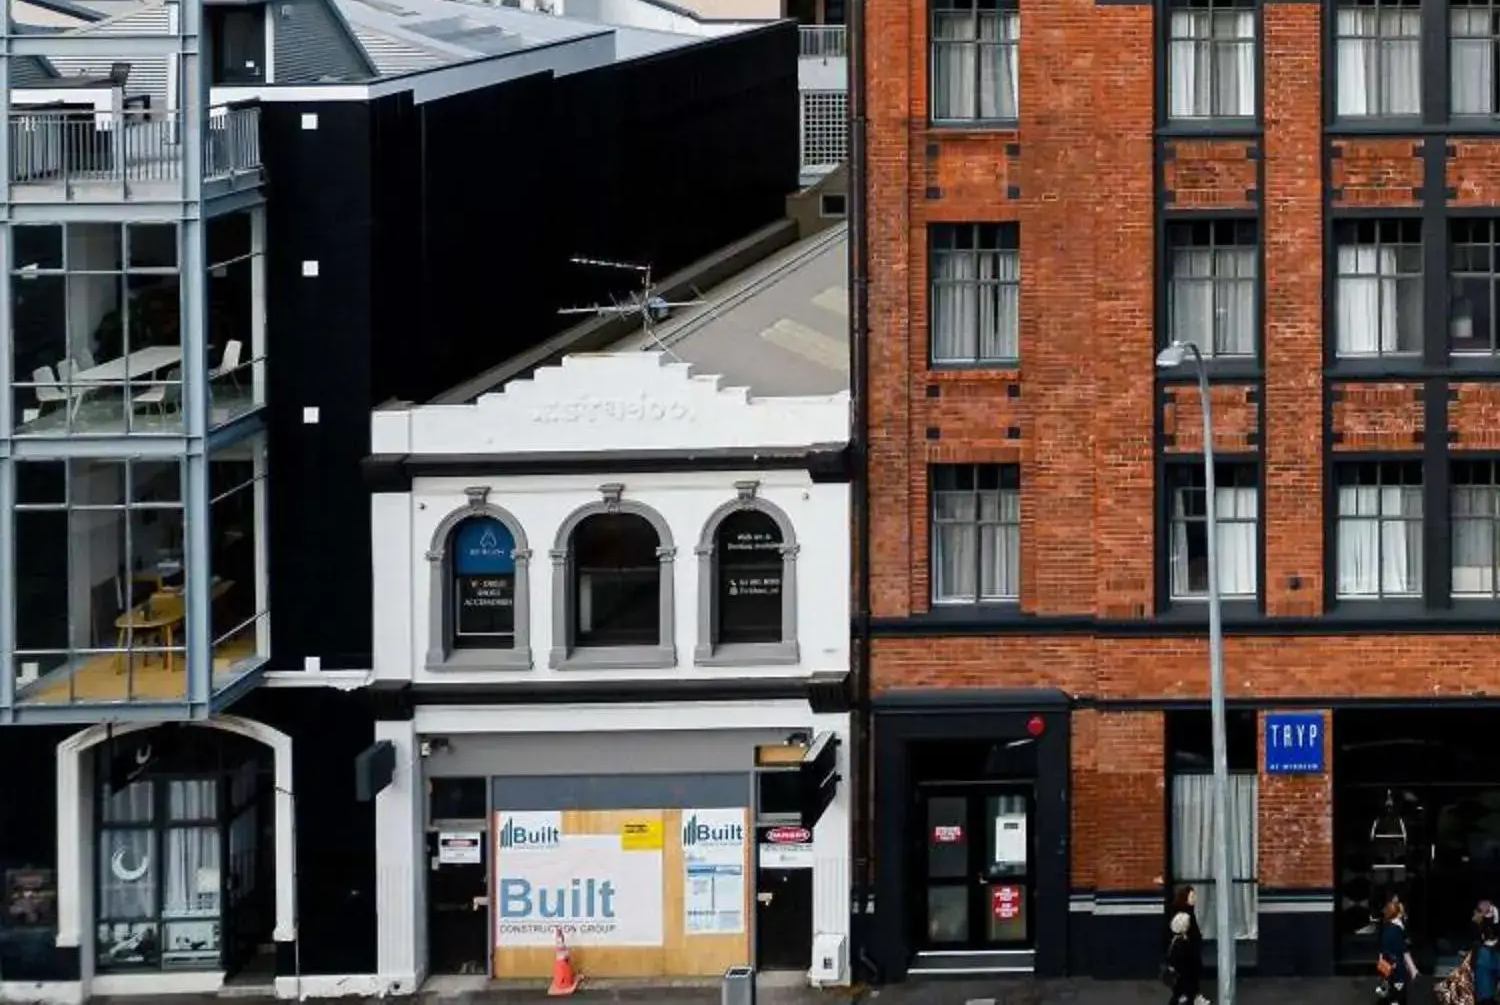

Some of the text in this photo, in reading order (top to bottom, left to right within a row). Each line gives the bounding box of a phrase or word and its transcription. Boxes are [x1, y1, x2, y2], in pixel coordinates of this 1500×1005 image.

[1271, 724, 1318, 748] TRYP
[513, 826, 559, 844] Built
[697, 824, 742, 841] Built
[500, 878, 615, 918] Built
[580, 924, 616, 934] GROUP
